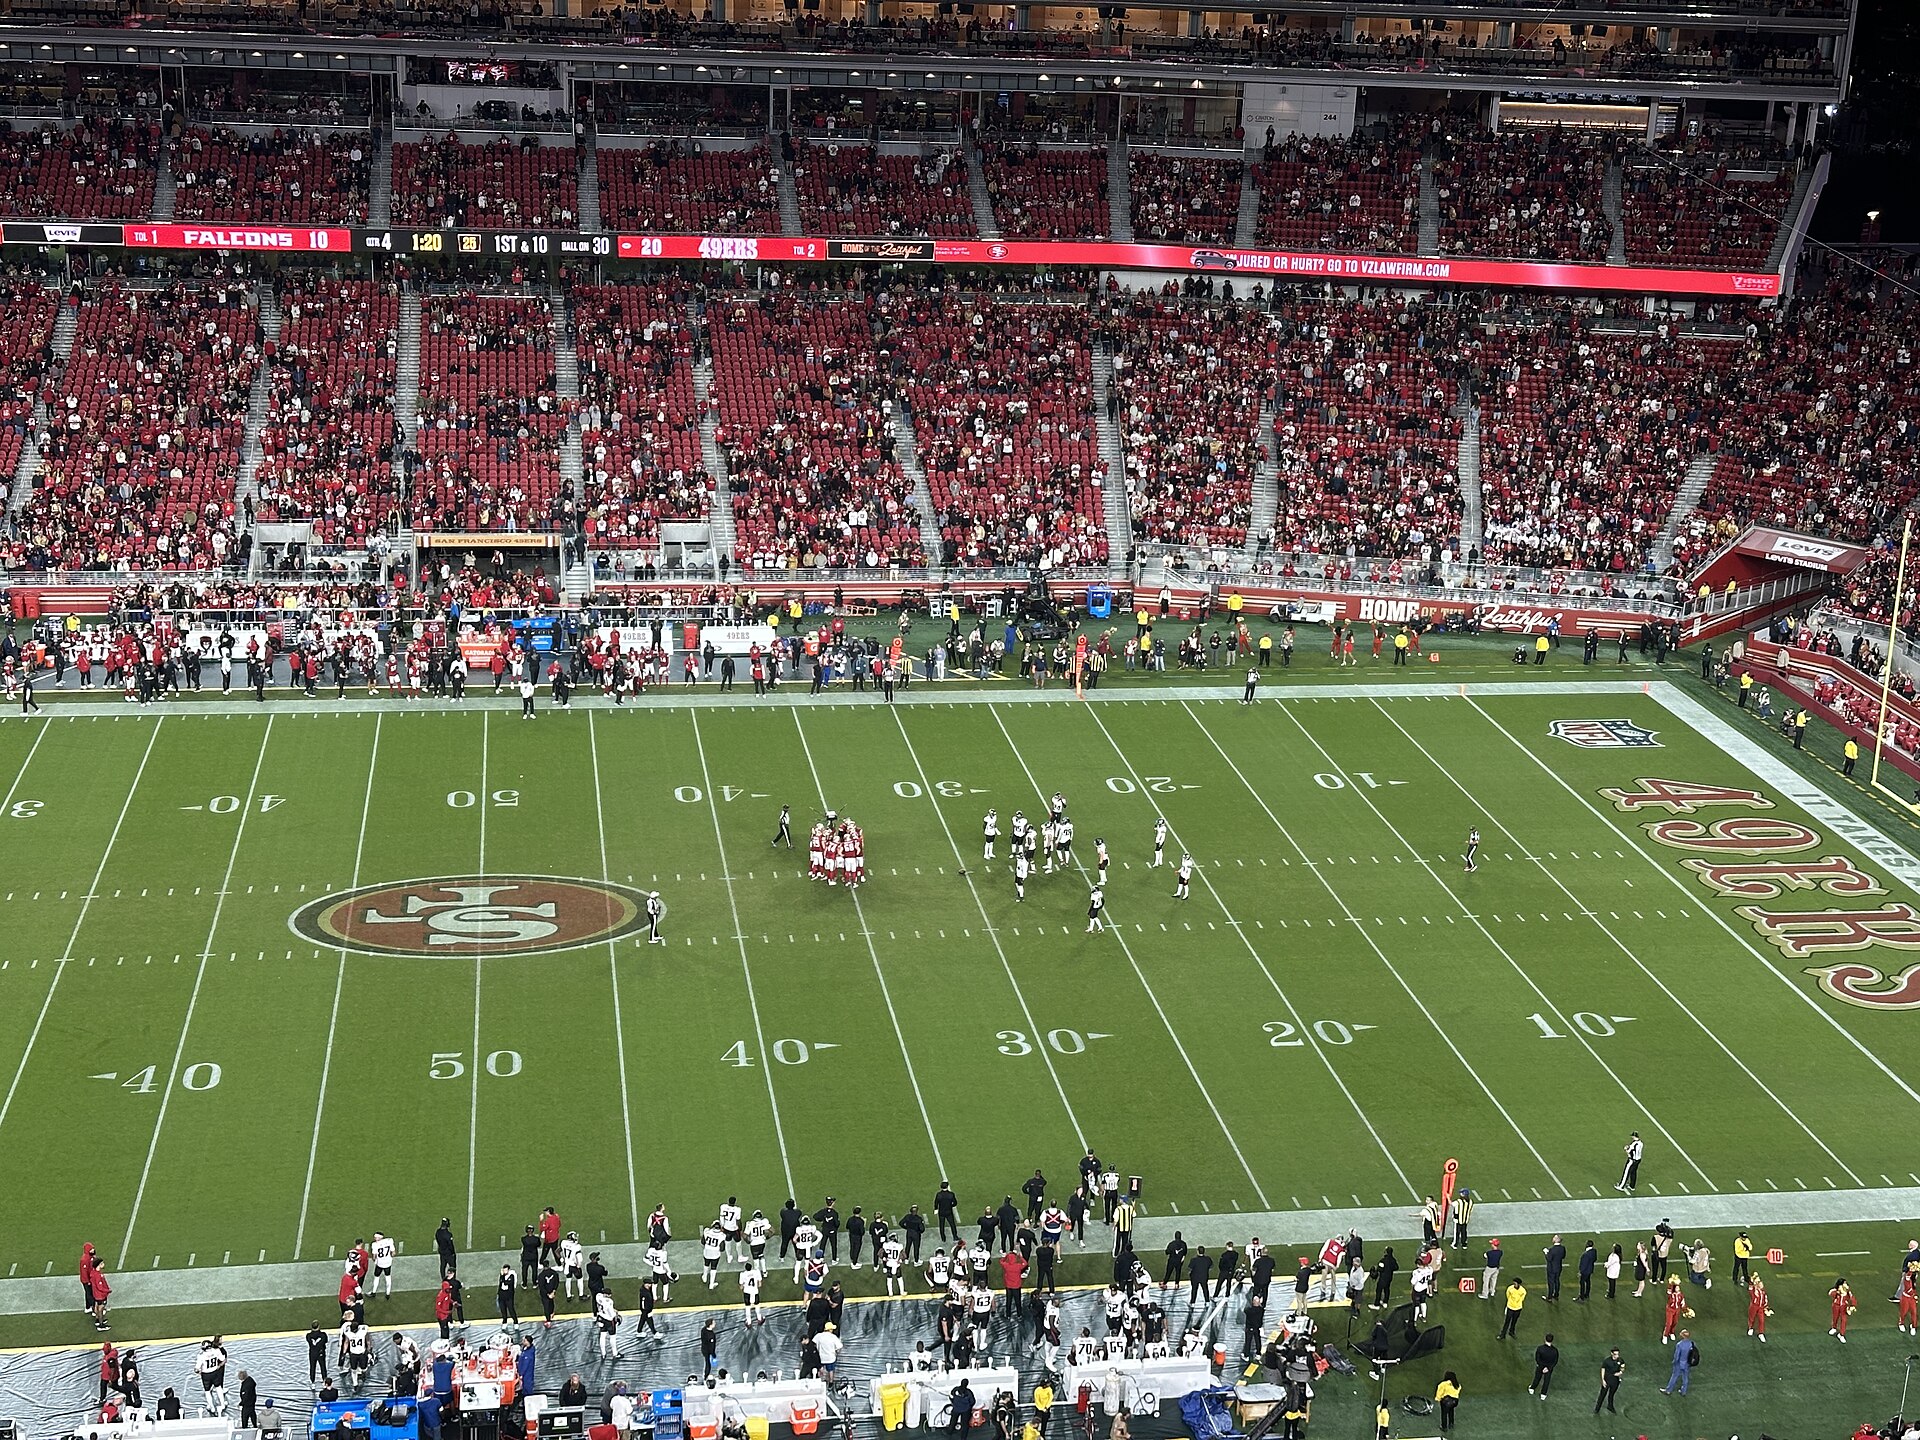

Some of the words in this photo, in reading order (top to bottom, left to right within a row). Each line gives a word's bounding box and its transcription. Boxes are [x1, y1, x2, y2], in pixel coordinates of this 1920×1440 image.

[151, 230, 158, 244] 1
[183, 230, 293, 247] FALCONS
[309, 231, 329, 248] 10
[381, 232, 392, 250] 4
[412, 233, 442, 251] 1:20
[494, 235, 519, 253] 1ST
[520, 240, 530, 254] &
[532, 235, 548, 254] 10
[561, 241, 578, 252] BALL
[578, 241, 590, 252] ON
[592, 236, 610, 255] 30
[640, 238, 663, 256] 20
[698, 237, 759, 260] 49ERS
[807, 243, 816, 258] 2
[841, 243, 864, 254] HOME
[1273, 255, 1288, 269] OR
[1290, 256, 1324, 272] HURT?
[1327, 258, 1341, 272] GO
[1344, 259, 1359, 273] TO
[1361, 260, 1450, 278] VZLAWFIRM.COM
[1794, 558, 1828, 572] STADIUM
[1359, 598, 1421, 622] HOME
[1420, 606, 1436, 618] OF
[622, 632, 647, 641] 49ERS
[726, 632, 751, 640] 49ERS
[1561, 721, 1620, 747] NFL
[1791, 793, 1836, 807] IT
[1823, 814, 1898, 868] TAKES
[1596, 776, 1920, 1011] 49ERS
[722, 1210, 735, 1222] 27
[801, 1232, 813, 1243] 82
[377, 1245, 392, 1258] 87
[1771, 1250, 1782, 1262] 10
[934, 1262, 947, 1273] 85
[972, 1257, 985, 1268] 23
[747, 1277, 756, 1287] 4
[1462, 1280, 1474, 1290] 20
[976, 1295, 991, 1307] 63
[1078, 1343, 1092, 1355] 70
[1110, 1341, 1124, 1353] 65
[1152, 1346, 1167, 1360] 64
[205, 1357, 218, 1369] 18
